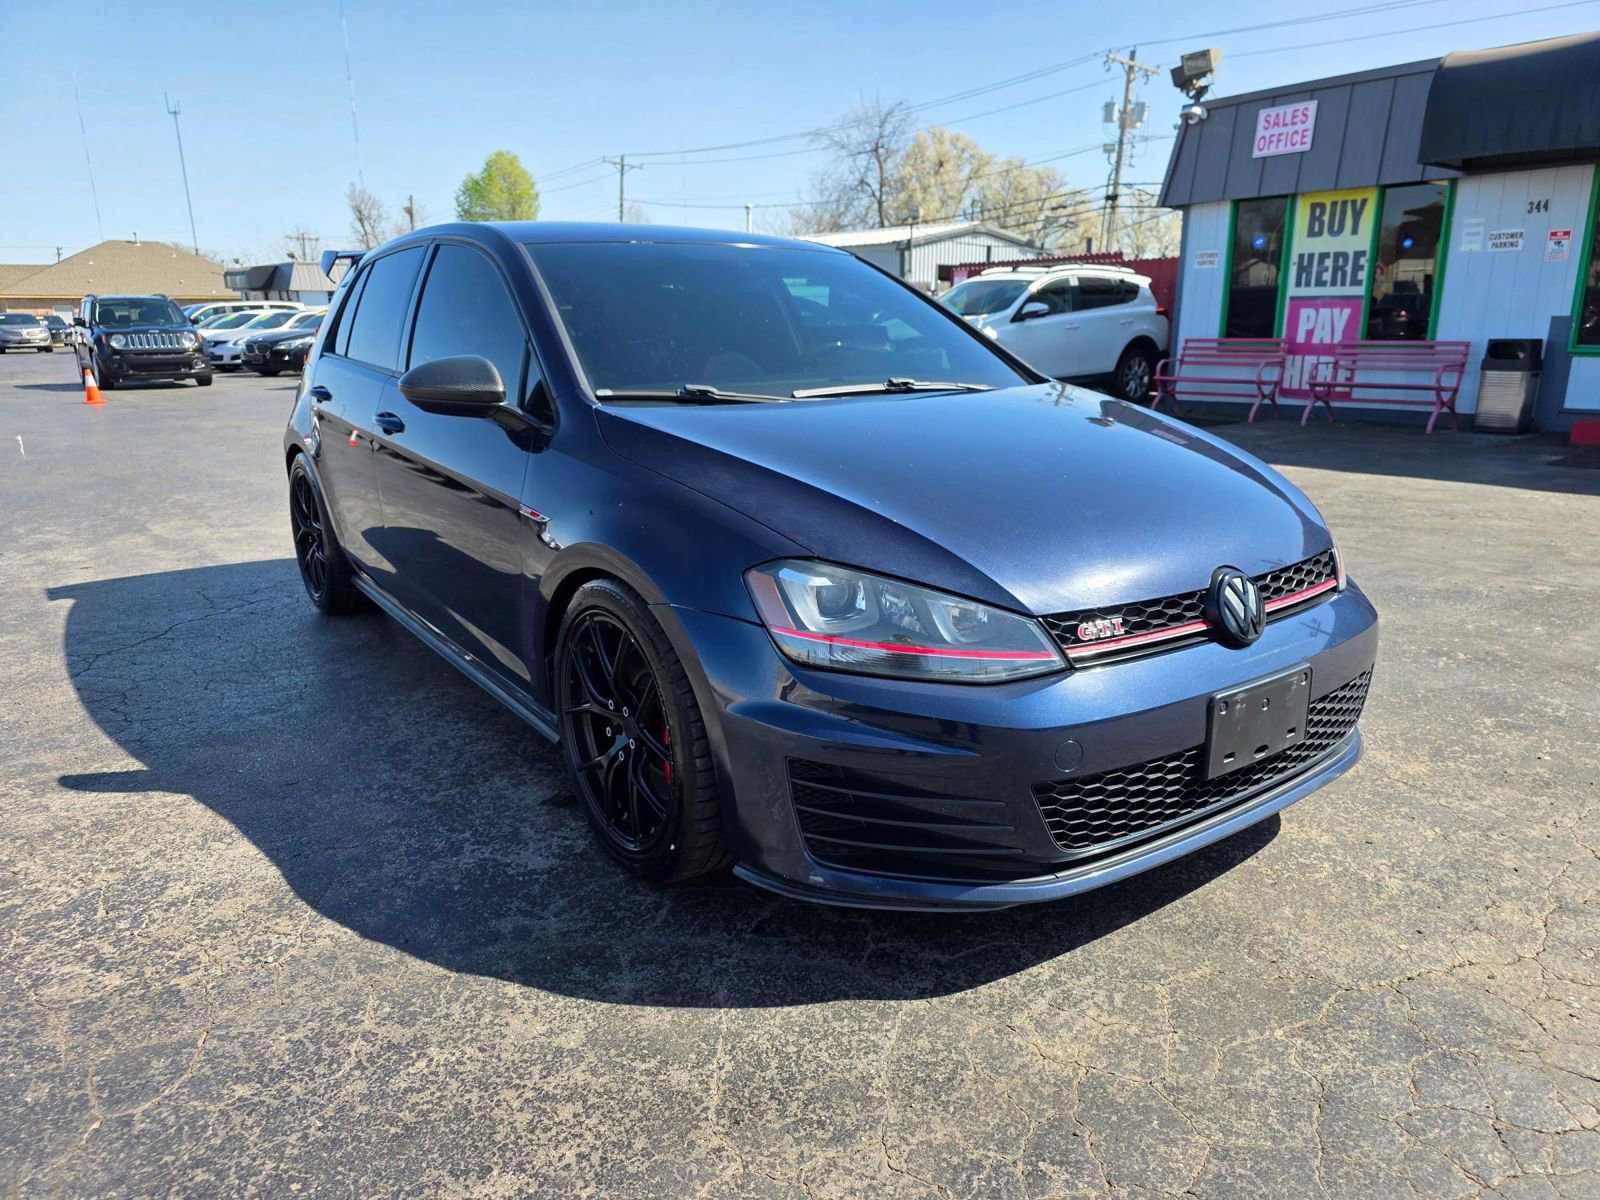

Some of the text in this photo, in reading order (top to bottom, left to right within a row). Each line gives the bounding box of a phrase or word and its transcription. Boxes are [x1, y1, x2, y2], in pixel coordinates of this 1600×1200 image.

[1263, 106, 1309, 131] SALES
[1257, 128, 1309, 152] OFFICE
[1307, 197, 1369, 238] BUY
[1528, 199, 1550, 214] 344
[1489, 231, 1524, 241] CUSTOMER
[1491, 240, 1519, 249] PARKING
[1295, 250, 1367, 288] HERE
[1296, 307, 1352, 344] PAY
[1078, 617, 1125, 641] GTI
